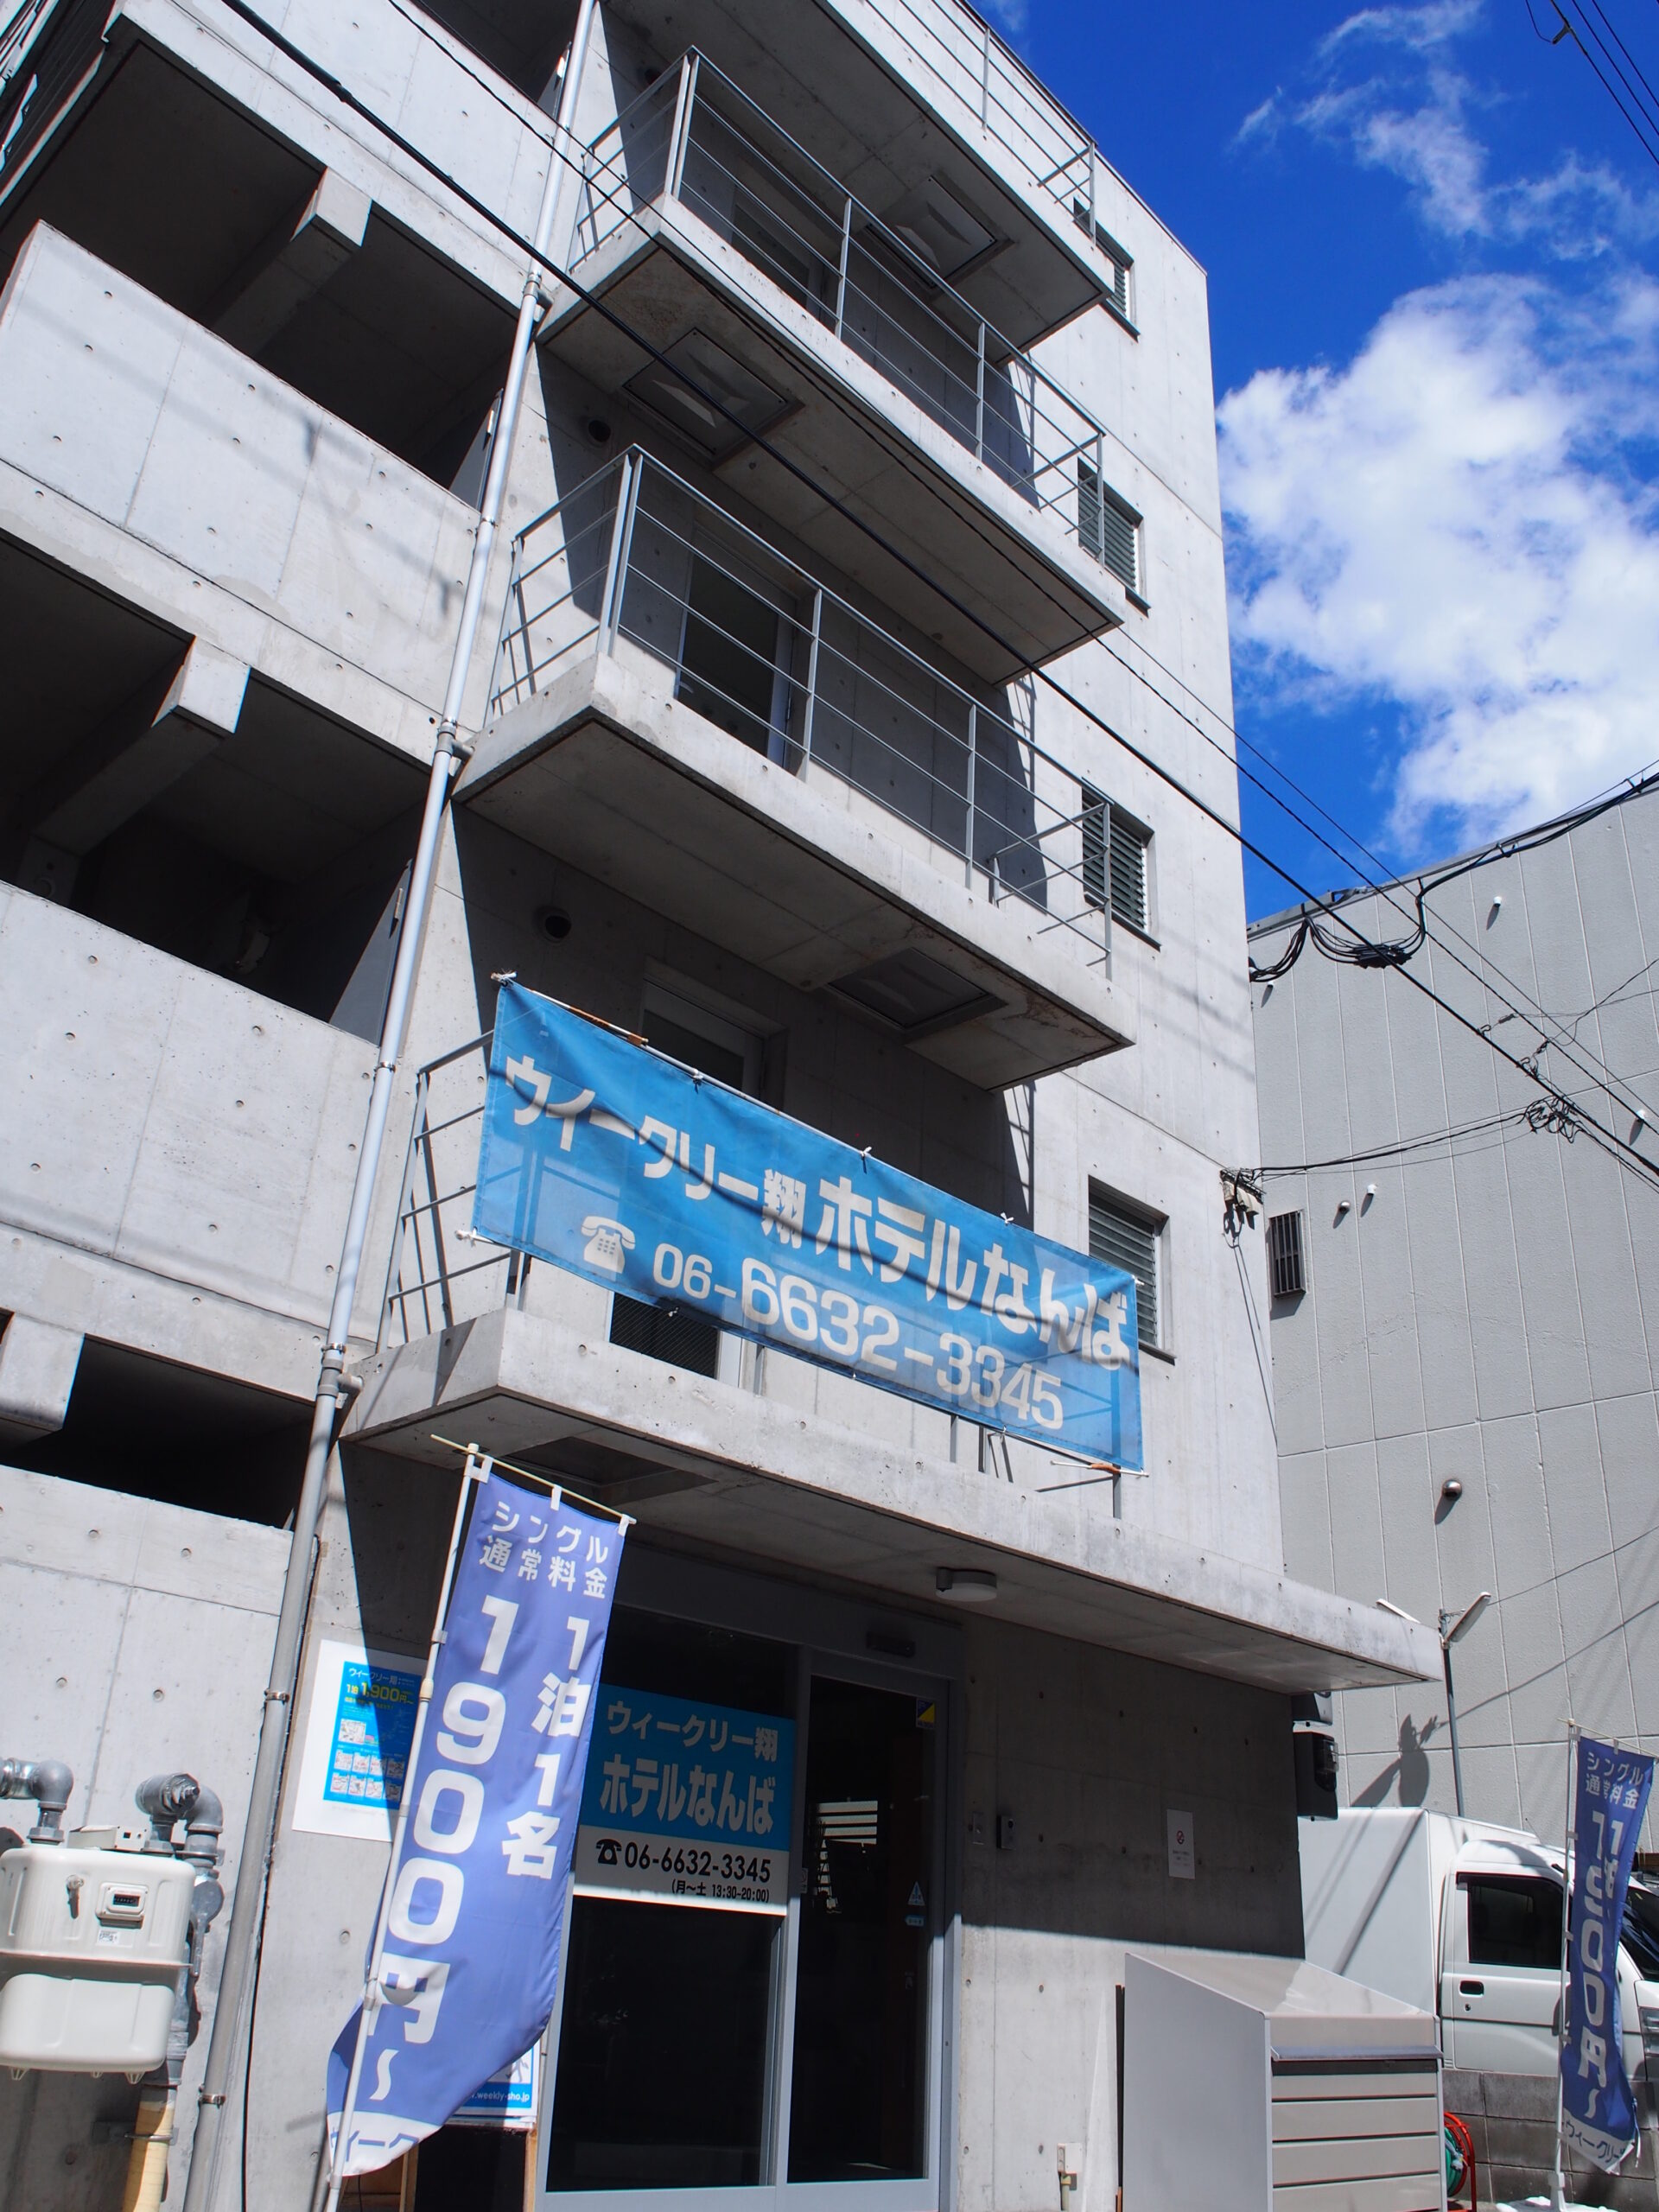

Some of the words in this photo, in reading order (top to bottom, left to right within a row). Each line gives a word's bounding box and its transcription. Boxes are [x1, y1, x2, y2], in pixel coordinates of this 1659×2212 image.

[652, 1243, 1064, 1431] 06-6632-3345
[492, 1500, 609, 1564] シングル
[479, 1535, 607, 1599] 通常料金
[501, 1615, 591, 1880] 1泊1名
[607, 1700, 778, 1763] ウィークリー翔
[600, 1752, 776, 1835] ホテルなんば
[1586, 1751, 1643, 1787] シングル
[624, 1841, 771, 1884] 06-6632-3345
